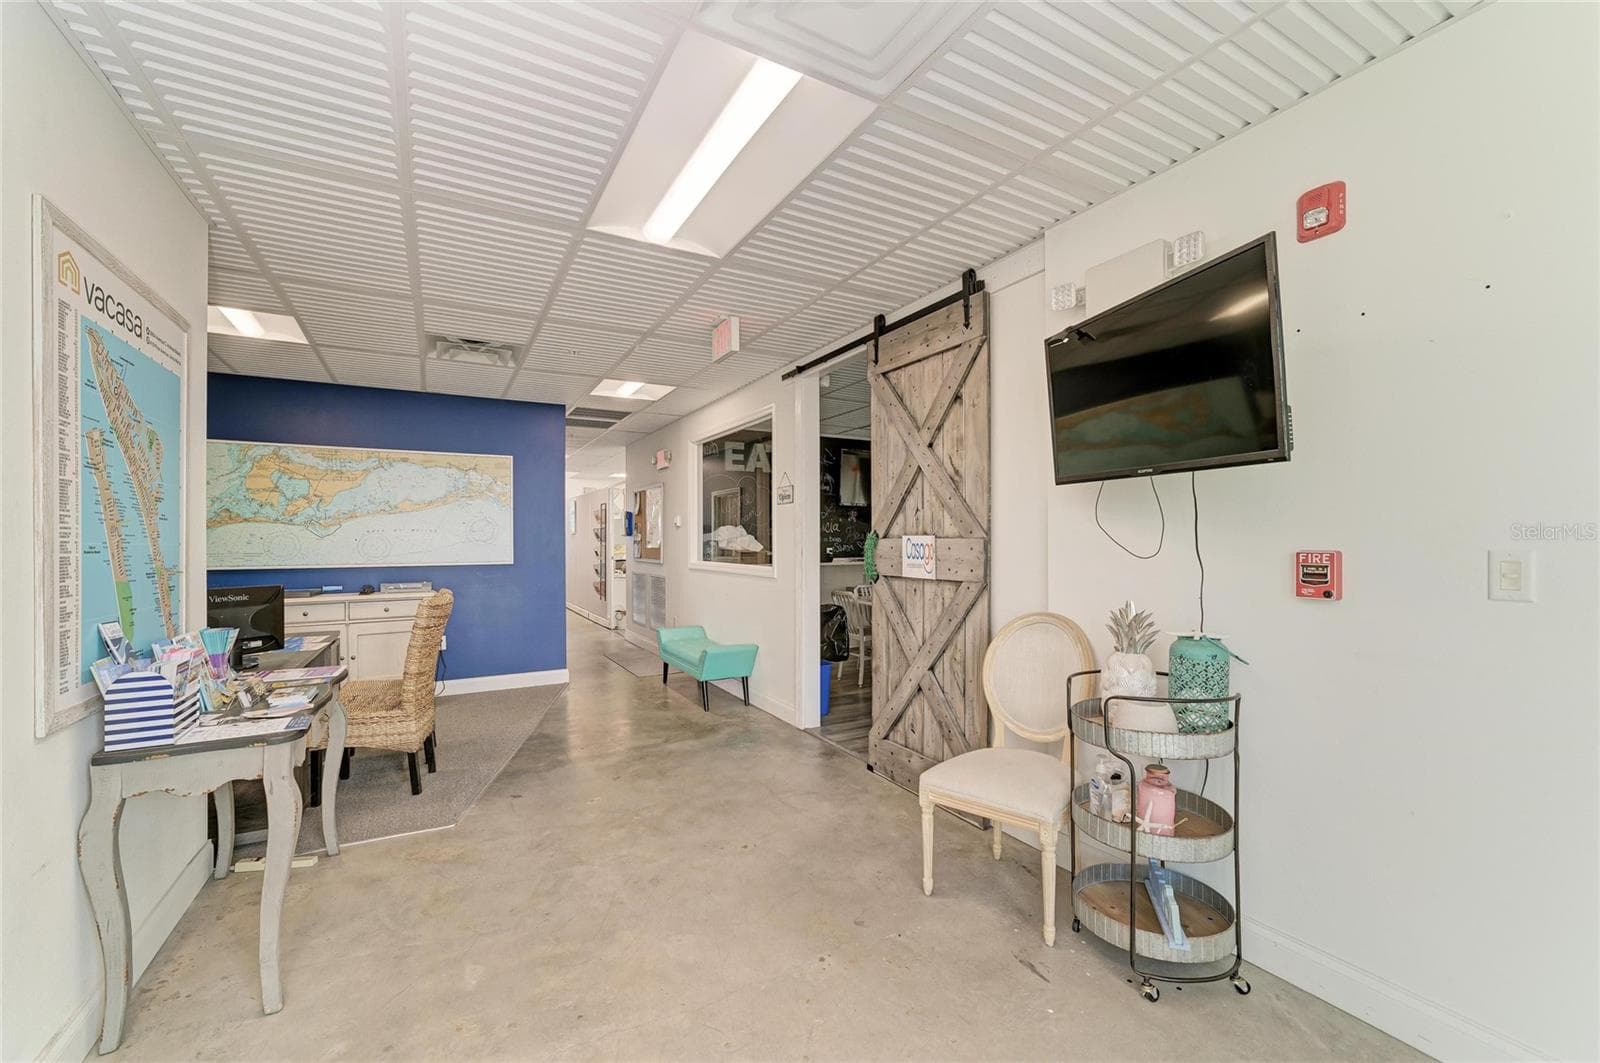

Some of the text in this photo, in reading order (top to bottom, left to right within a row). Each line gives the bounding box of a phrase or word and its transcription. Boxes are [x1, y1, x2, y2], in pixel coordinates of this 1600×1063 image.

[84, 276, 143, 340] vacasa
[1299, 553, 1331, 564] FIRE
[208, 593, 250, 603] ViewSonic
